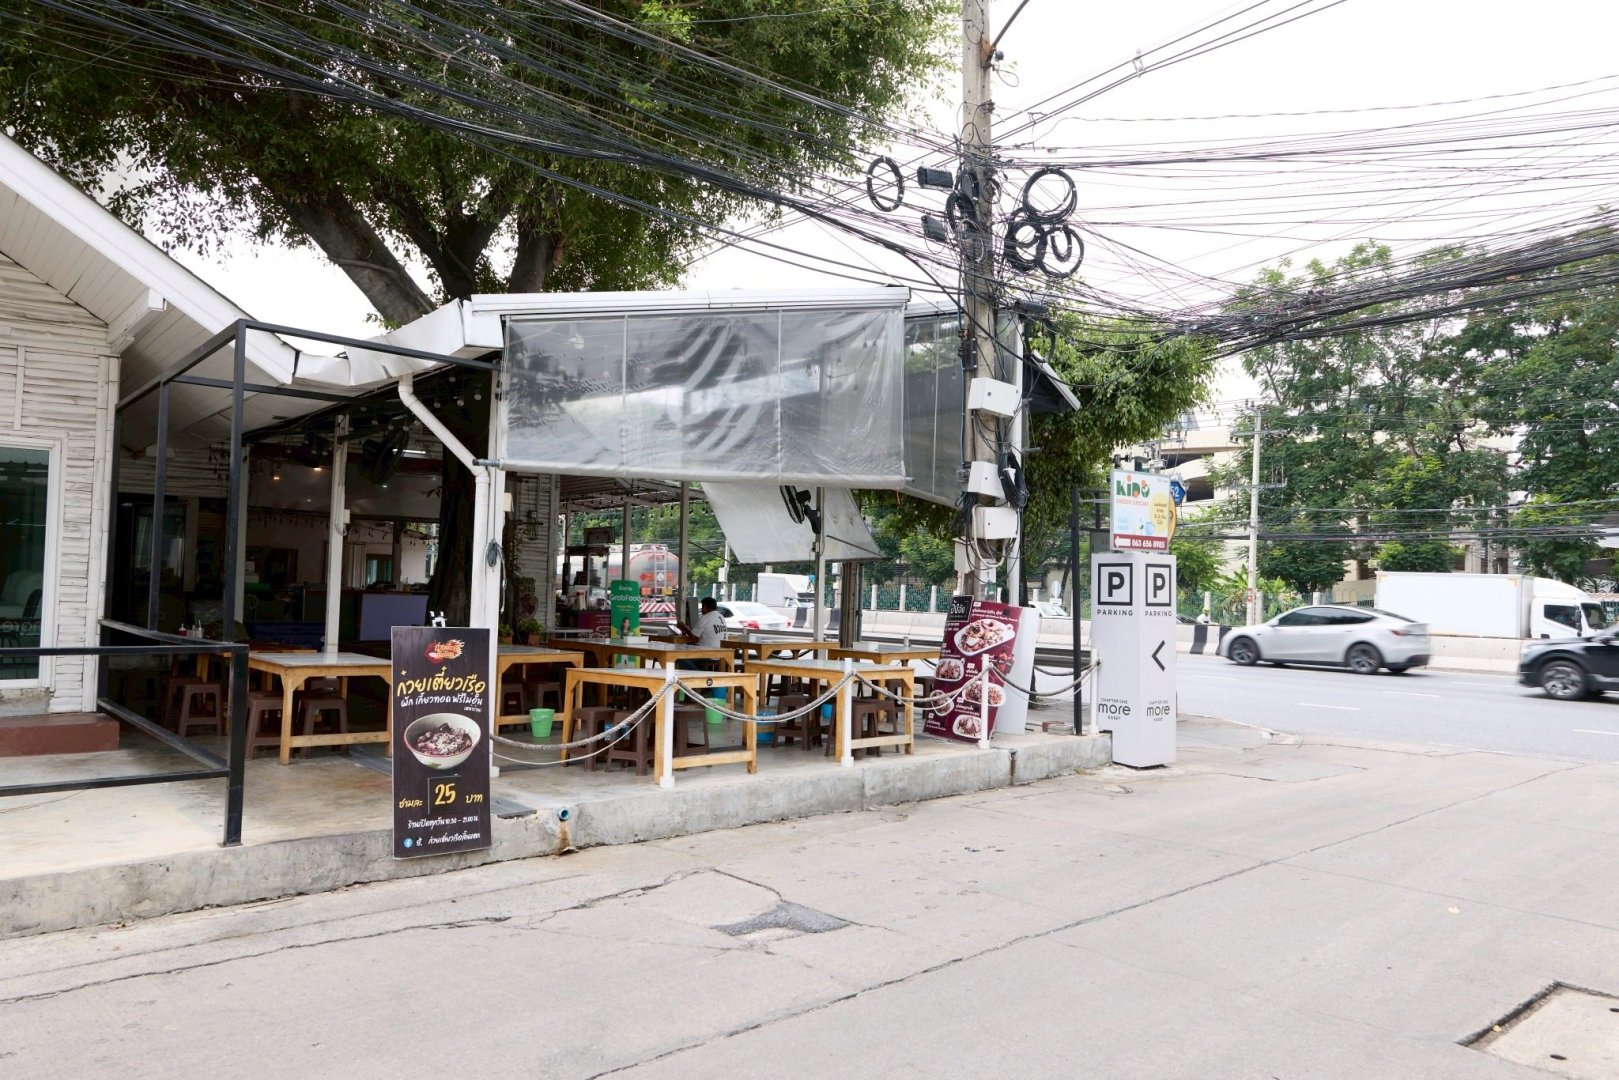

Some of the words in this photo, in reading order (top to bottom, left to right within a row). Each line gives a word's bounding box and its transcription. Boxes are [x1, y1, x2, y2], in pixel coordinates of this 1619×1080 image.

[1132, 539, 1142, 547] 063
[1142, 539, 1152, 548] 656
[1108, 571, 1125, 597] P
[1153, 573, 1166, 598] P
[610, 593, 641, 602] GrabFood
[1096, 608, 1134, 616] PARKING
[1098, 703, 1131, 716] more
[1146, 705, 1171, 717] more
[434, 782, 457, 806] 25
[465, 793, 483, 804] บาท
